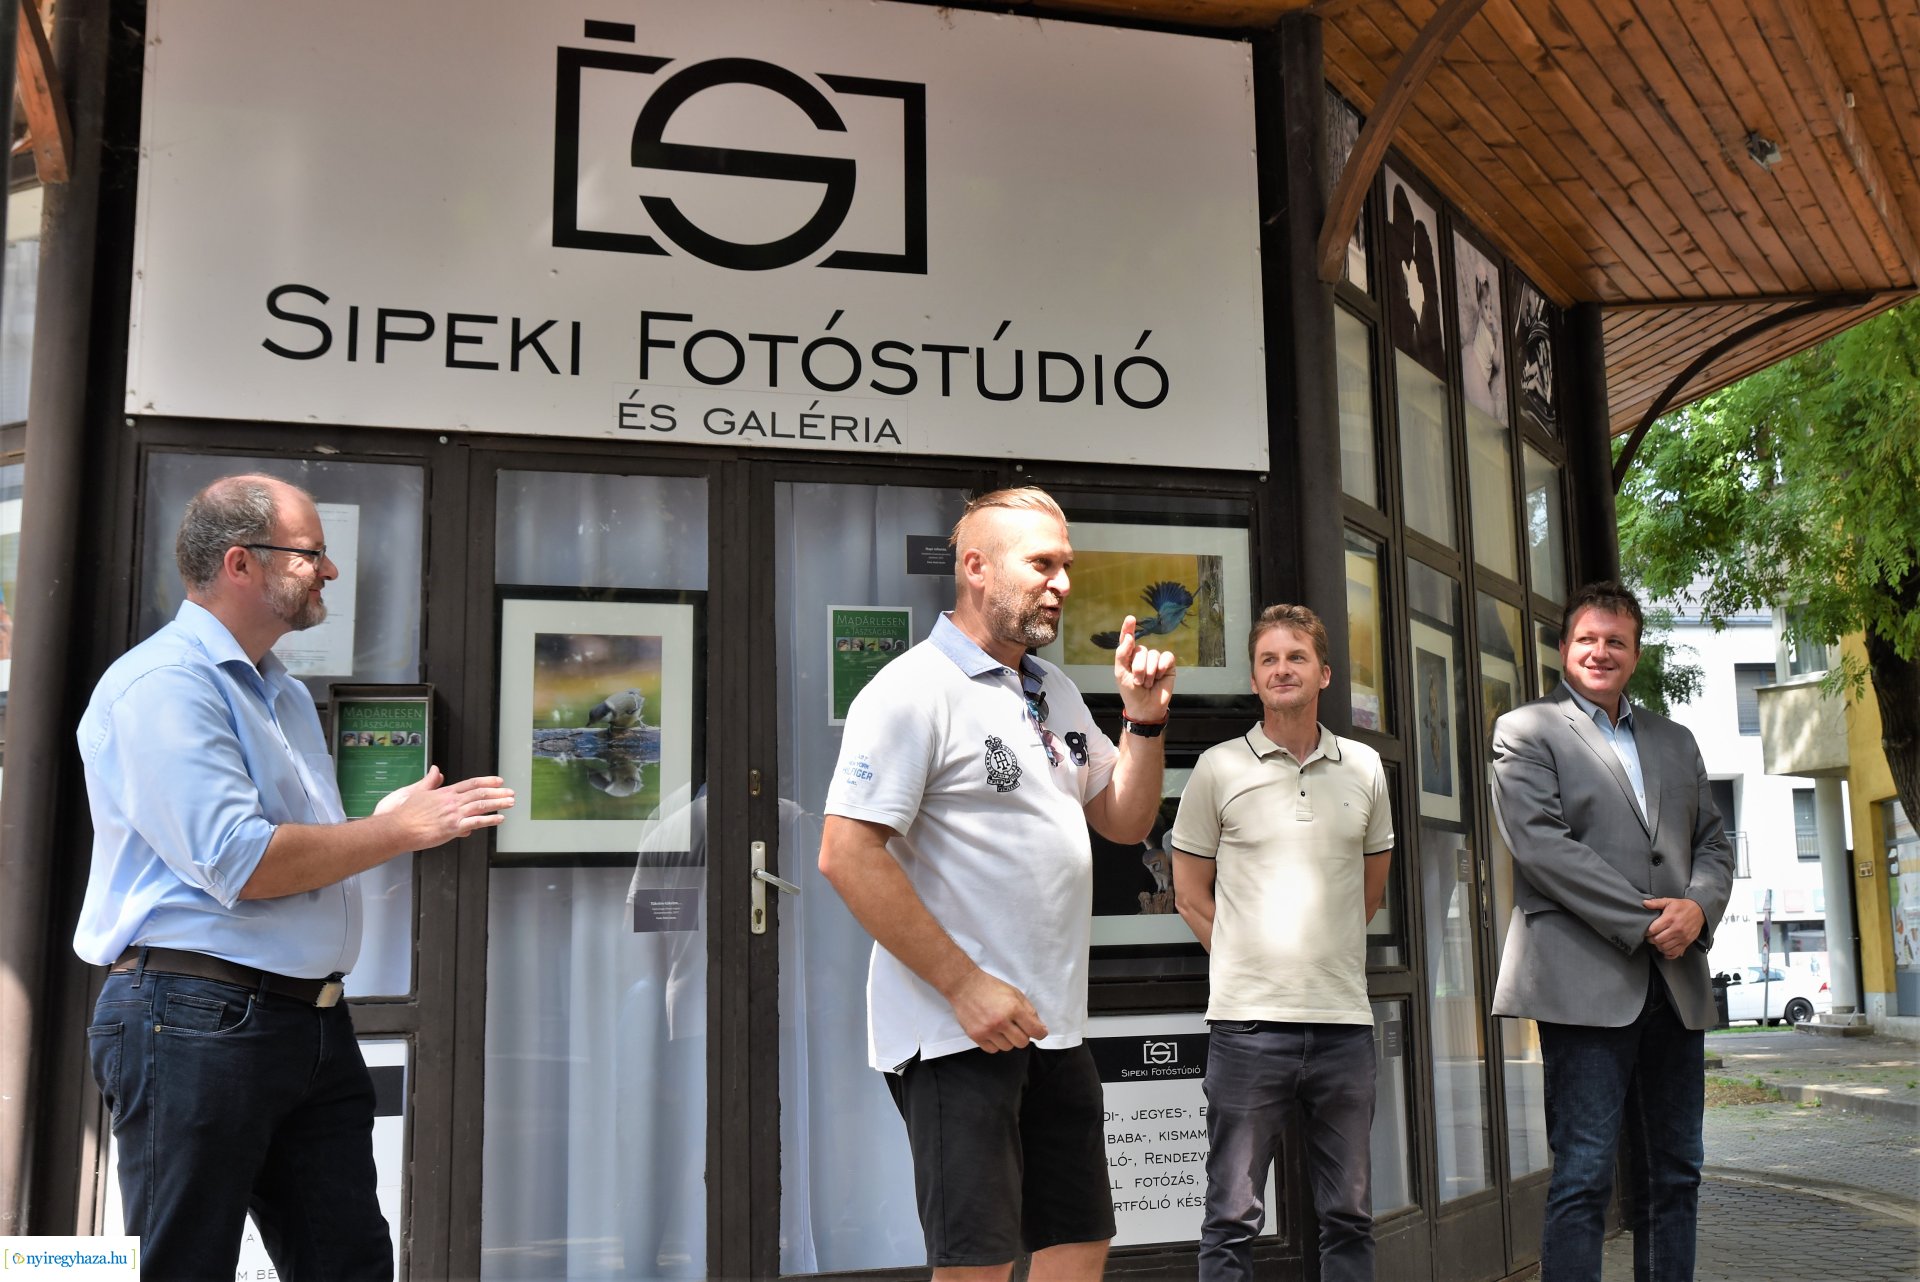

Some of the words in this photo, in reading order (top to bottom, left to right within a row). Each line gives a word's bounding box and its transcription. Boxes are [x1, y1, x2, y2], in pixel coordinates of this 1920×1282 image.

[262, 284, 581, 376] SIPEKI
[639, 309, 1170, 410] FOTÓSTÚDIÓ
[618, 389, 678, 432] ÉS
[703, 400, 902, 445] GALÉRIA
[836, 614, 906, 626] MADÁRLESEN
[343, 706, 422, 718] MADÁRLESEN
[843, 767, 873, 782] LFIGER
[1121, 1068, 1148, 1078] SIPEKI
[1151, 1065, 1201, 1077] FOTÓSTÚDIÓ
[1107, 1133, 1151, 1144] BABA-,
[1159, 1129, 1209, 1141] KISMAM
[1106, 1151, 1137, 1167] LÓ-,
[1134, 1170, 1199, 1188] FOTÓZÁS,
